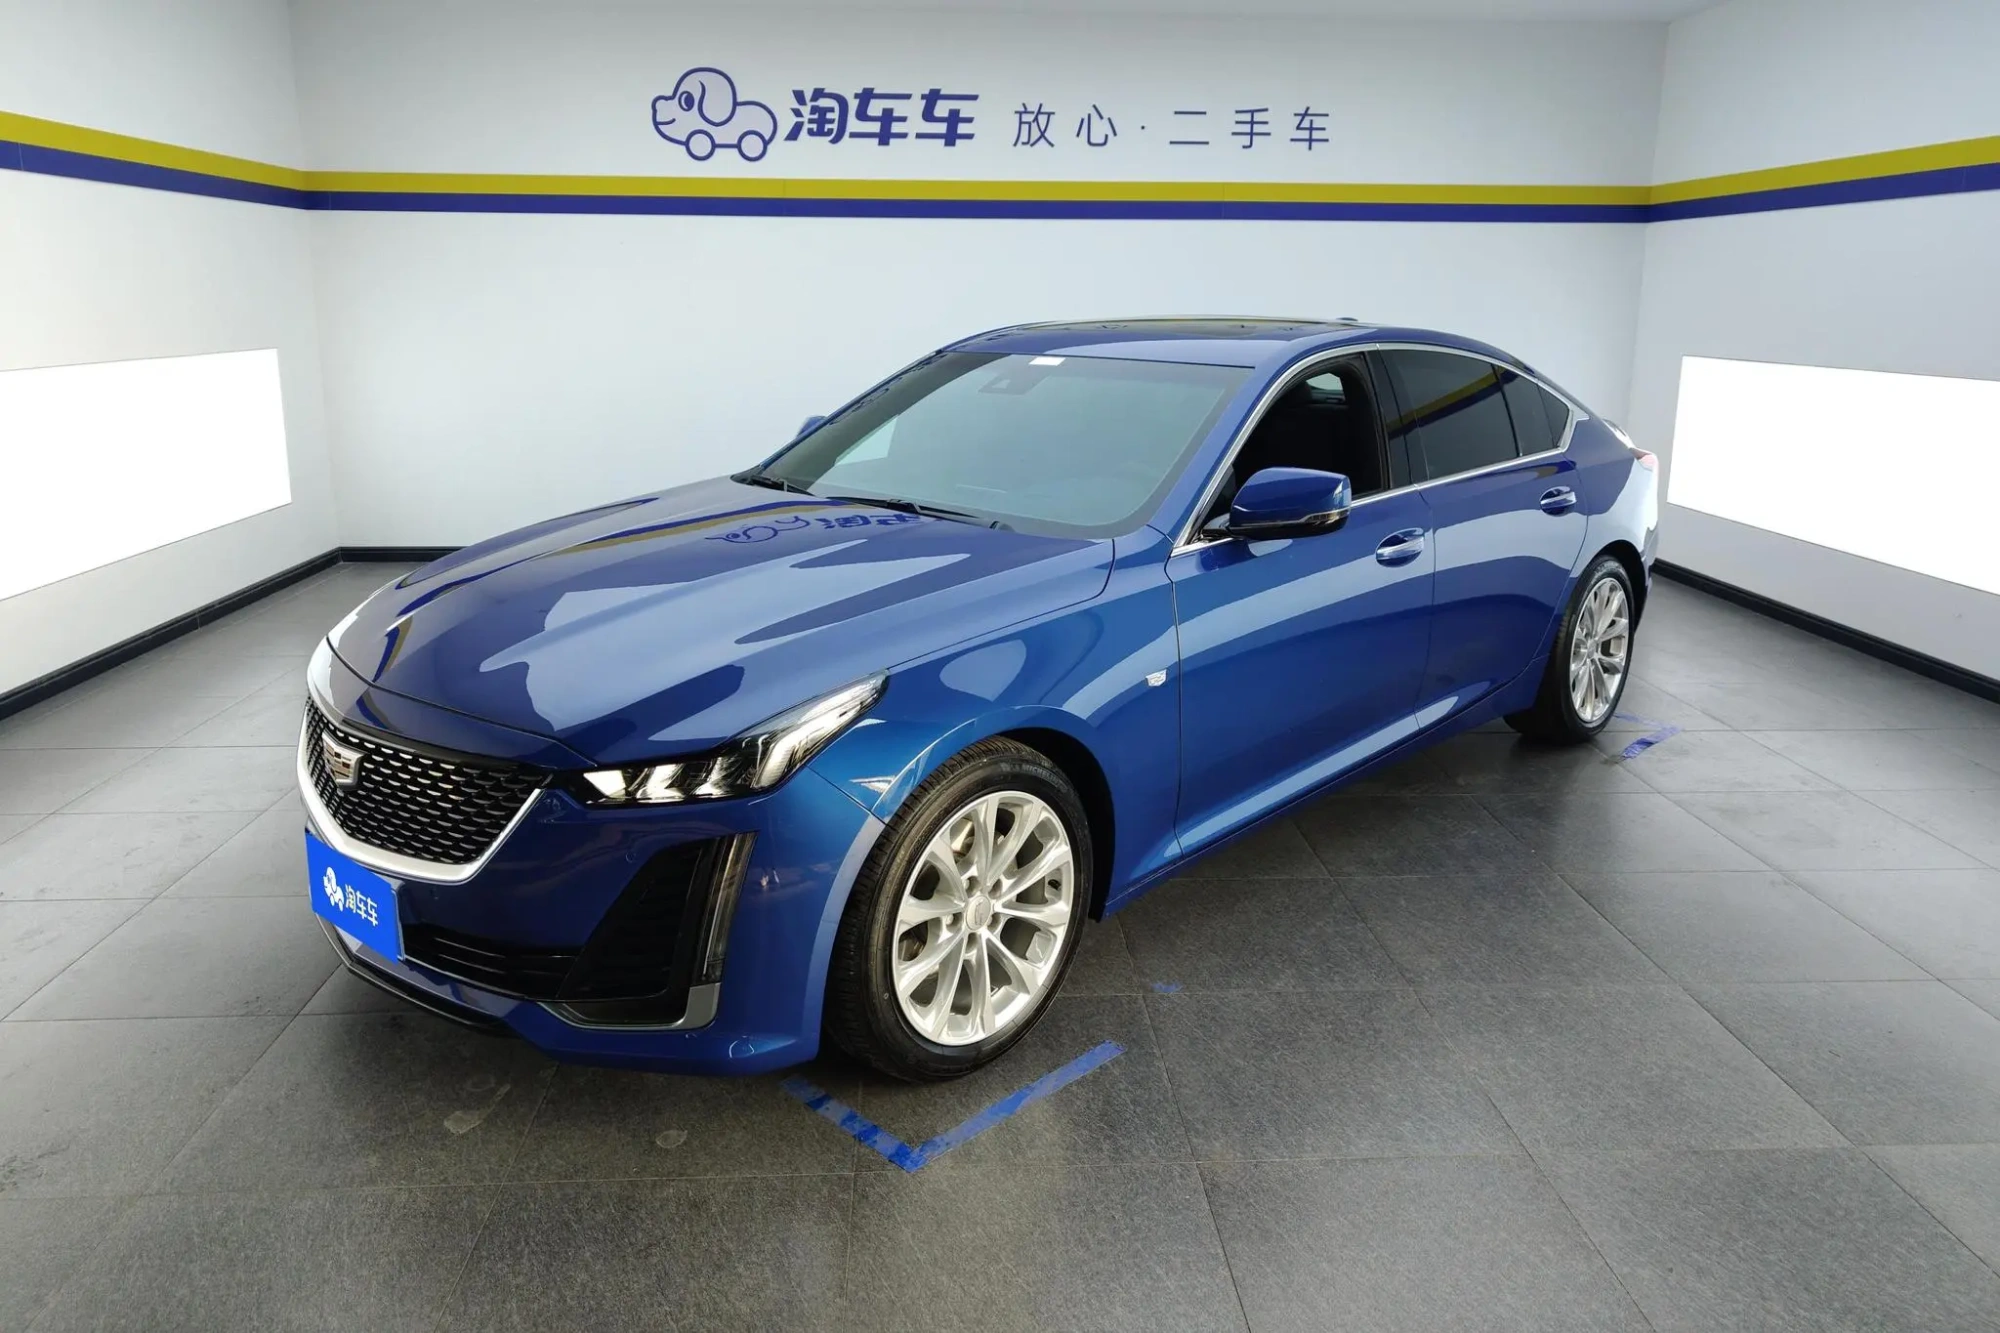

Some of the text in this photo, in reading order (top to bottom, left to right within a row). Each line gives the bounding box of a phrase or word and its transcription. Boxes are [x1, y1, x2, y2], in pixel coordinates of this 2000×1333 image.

[783, 87, 980, 147] 淘车车
[345, 884, 379, 927] 淘车车
